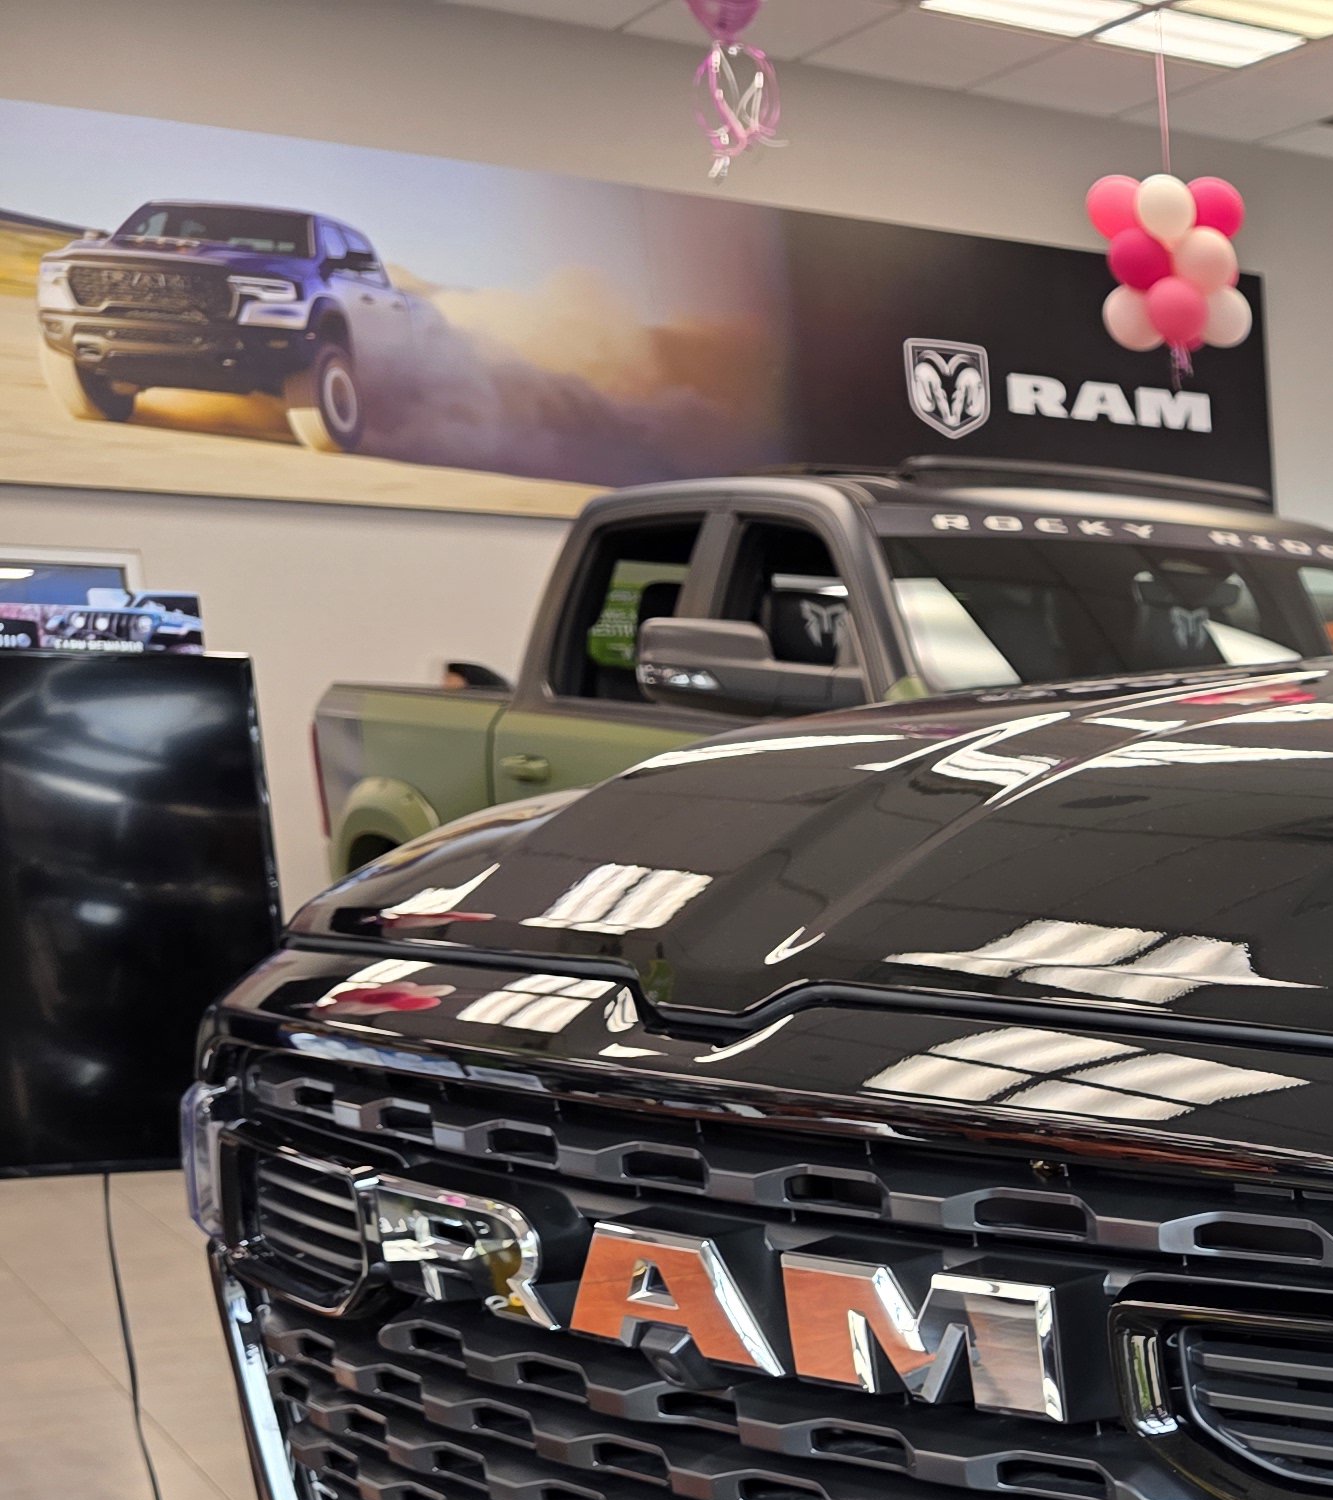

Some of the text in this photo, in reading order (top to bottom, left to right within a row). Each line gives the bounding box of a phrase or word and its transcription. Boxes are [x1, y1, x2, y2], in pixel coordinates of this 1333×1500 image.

[1006, 372, 1212, 433] RAM
[931, 513, 1154, 539] ROCKY
[354, 1166, 1065, 1423] RAM
